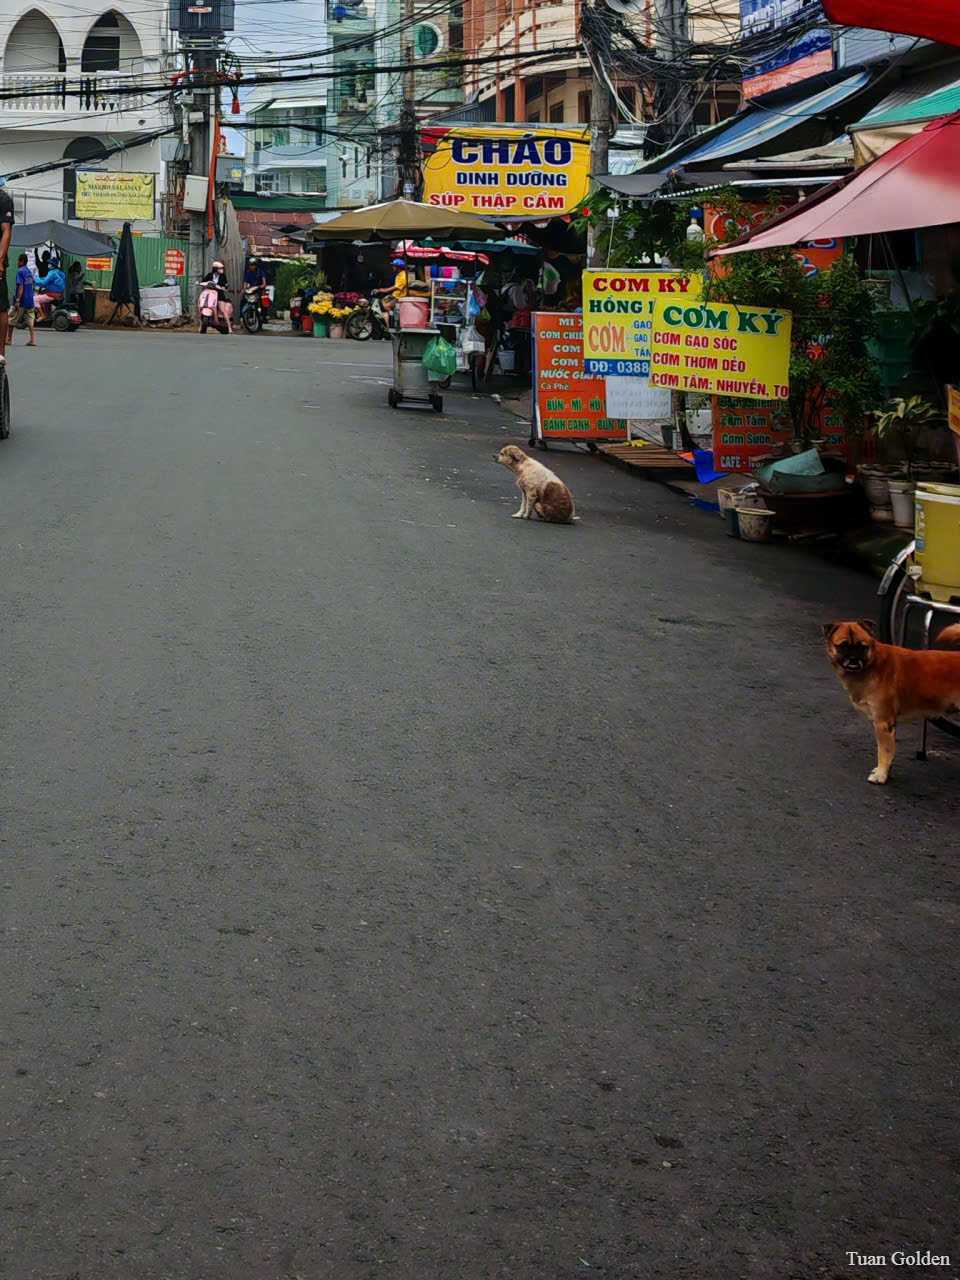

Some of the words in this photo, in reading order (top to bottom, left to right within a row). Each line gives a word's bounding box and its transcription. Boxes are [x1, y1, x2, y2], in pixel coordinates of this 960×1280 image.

[451, 134, 572, 165] CHÁO
[456, 172, 499, 185] DINH
[430, 191, 465, 206] SÚP
[593, 277, 649, 292] CƠM
[663, 304, 729, 330] CƠM
[588, 321, 626, 353] CƠM
[654, 331, 681, 346] CƠM
[617, 361, 649, 373] 0388
[652, 352, 680, 366] CƠM
[684, 355, 718, 370] THƠM
[651, 372, 679, 387] CƠM
